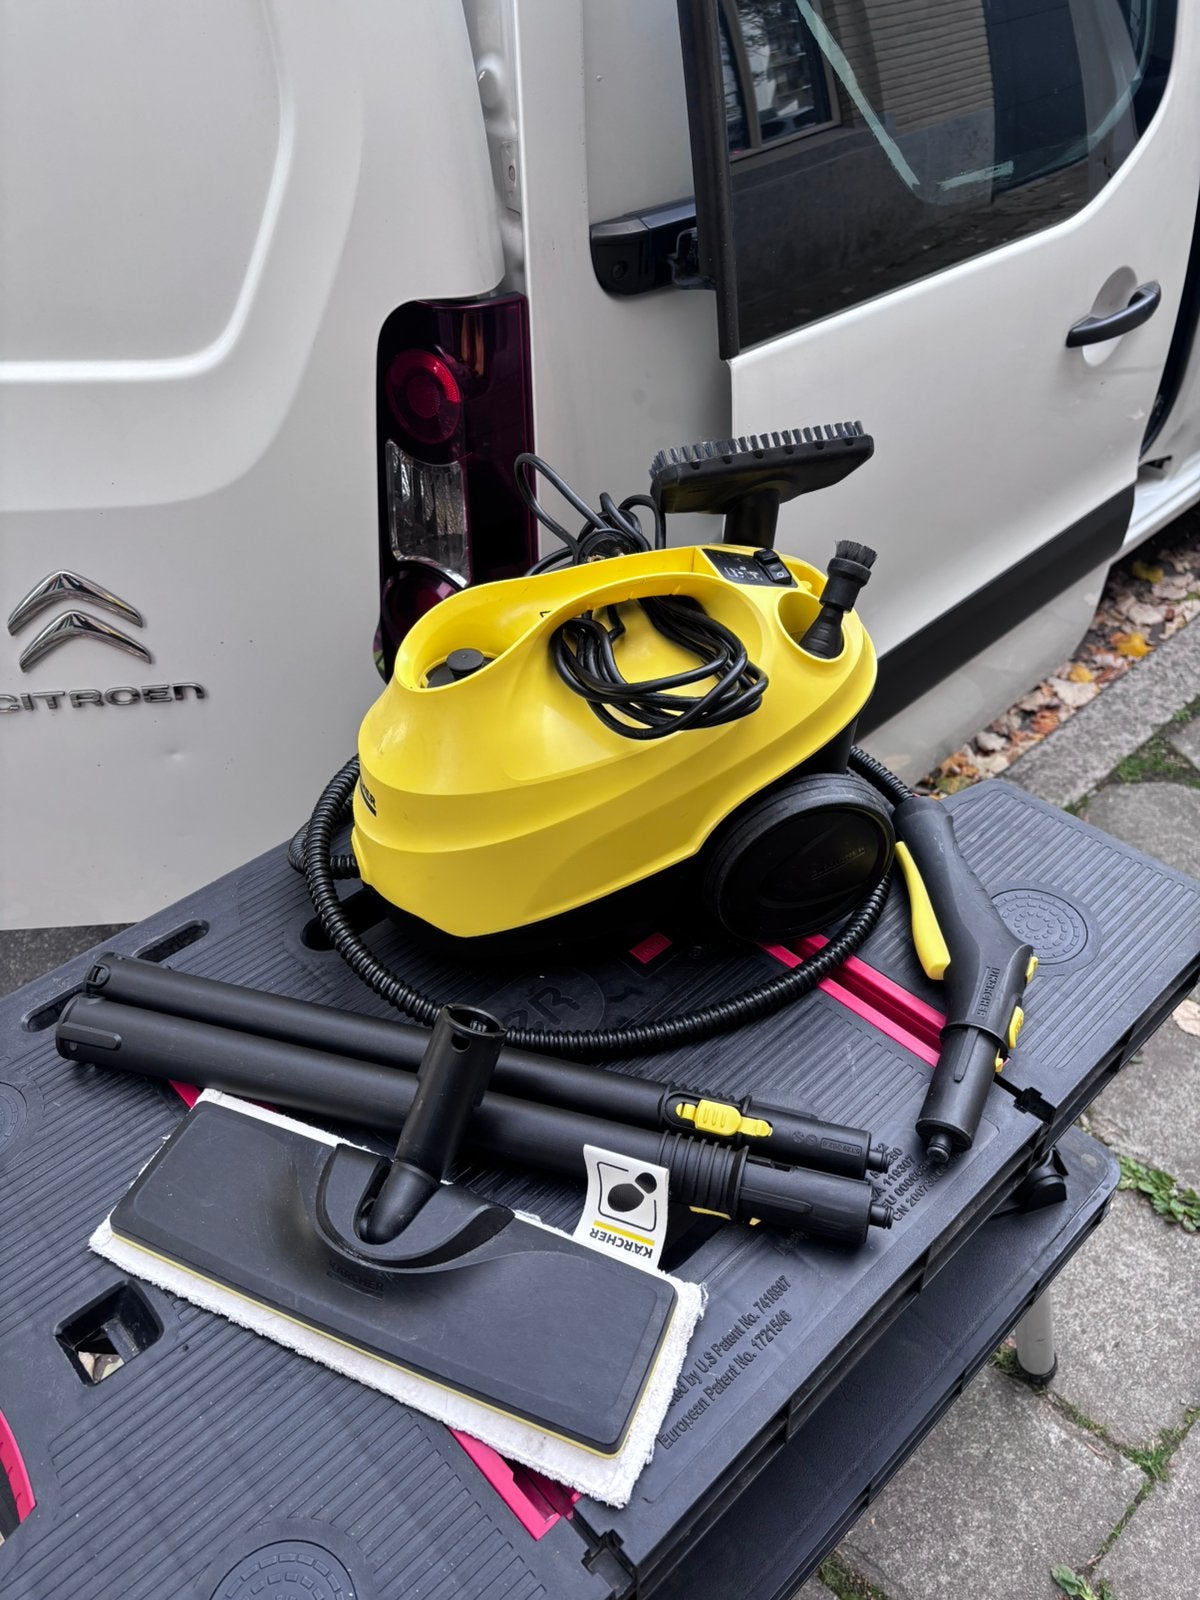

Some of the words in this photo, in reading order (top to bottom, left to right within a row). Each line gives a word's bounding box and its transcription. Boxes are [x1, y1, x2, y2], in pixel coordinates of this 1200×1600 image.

[892, 1204, 910, 1221] CN
[589, 1228, 654, 1259] KÄRCHER
[682, 1370, 703, 1387] by
[694, 1351, 718, 1373] U.S
[710, 1323, 746, 1357] Patent
[738, 1313, 761, 1330] No.
[655, 1397, 711, 1450] European
[703, 1364, 741, 1402] Patent
[733, 1351, 758, 1370] No.
[751, 1309, 793, 1351] 1721546
